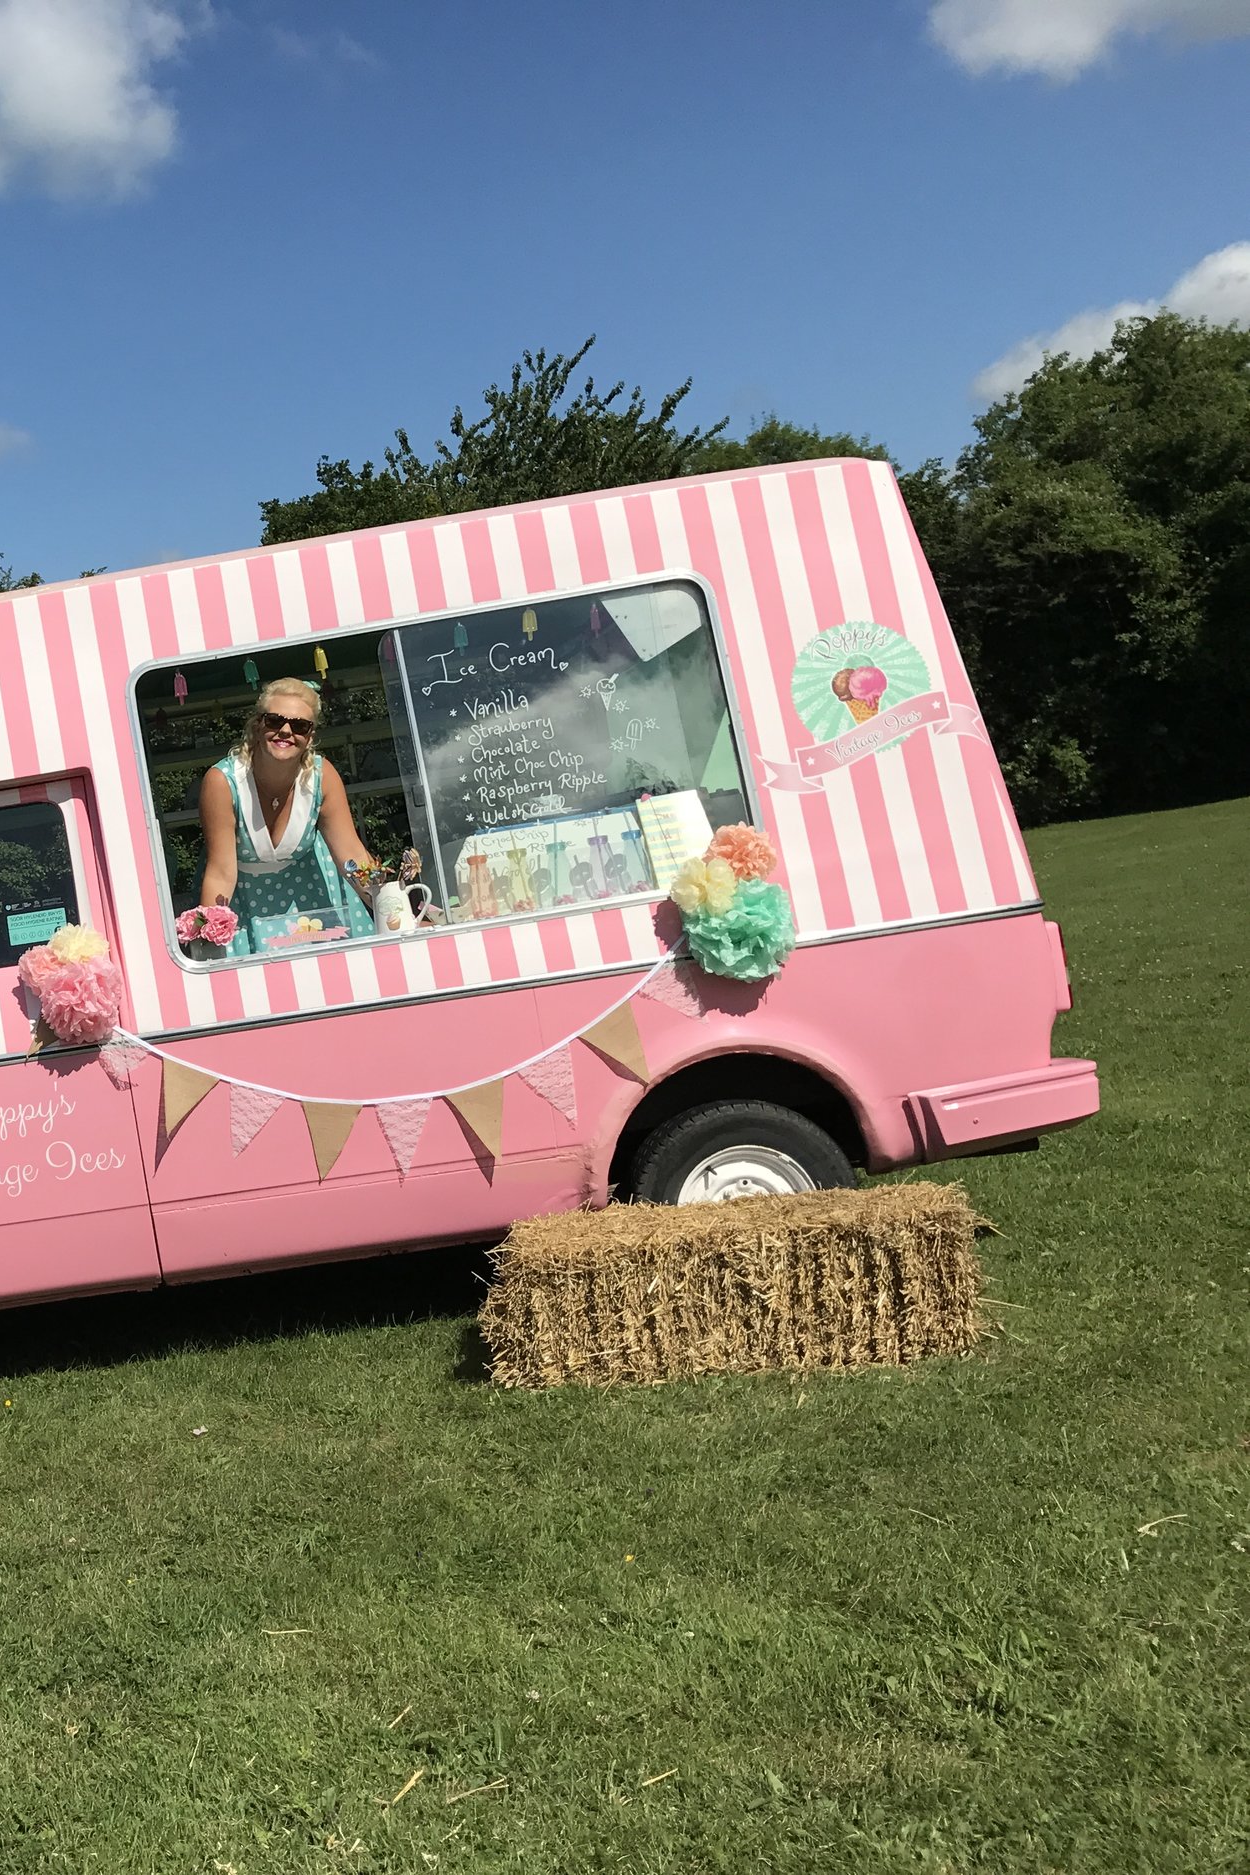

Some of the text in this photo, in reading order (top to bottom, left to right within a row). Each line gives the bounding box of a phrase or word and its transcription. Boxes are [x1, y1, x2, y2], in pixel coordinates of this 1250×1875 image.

[811, 629, 886, 660] Poppy's
[425, 642, 558, 687] Ice Cream
[463, 688, 529, 721] Vanilla
[468, 717, 555, 746] Strawberry
[471, 734, 541, 764] Chocolate
[826, 710, 922, 764] Vintage Ices
[473, 749, 584, 785] Mint Choc Chip
[475, 770, 608, 808] Raspberry Ripple
[45, 1141, 126, 1181] Ices
